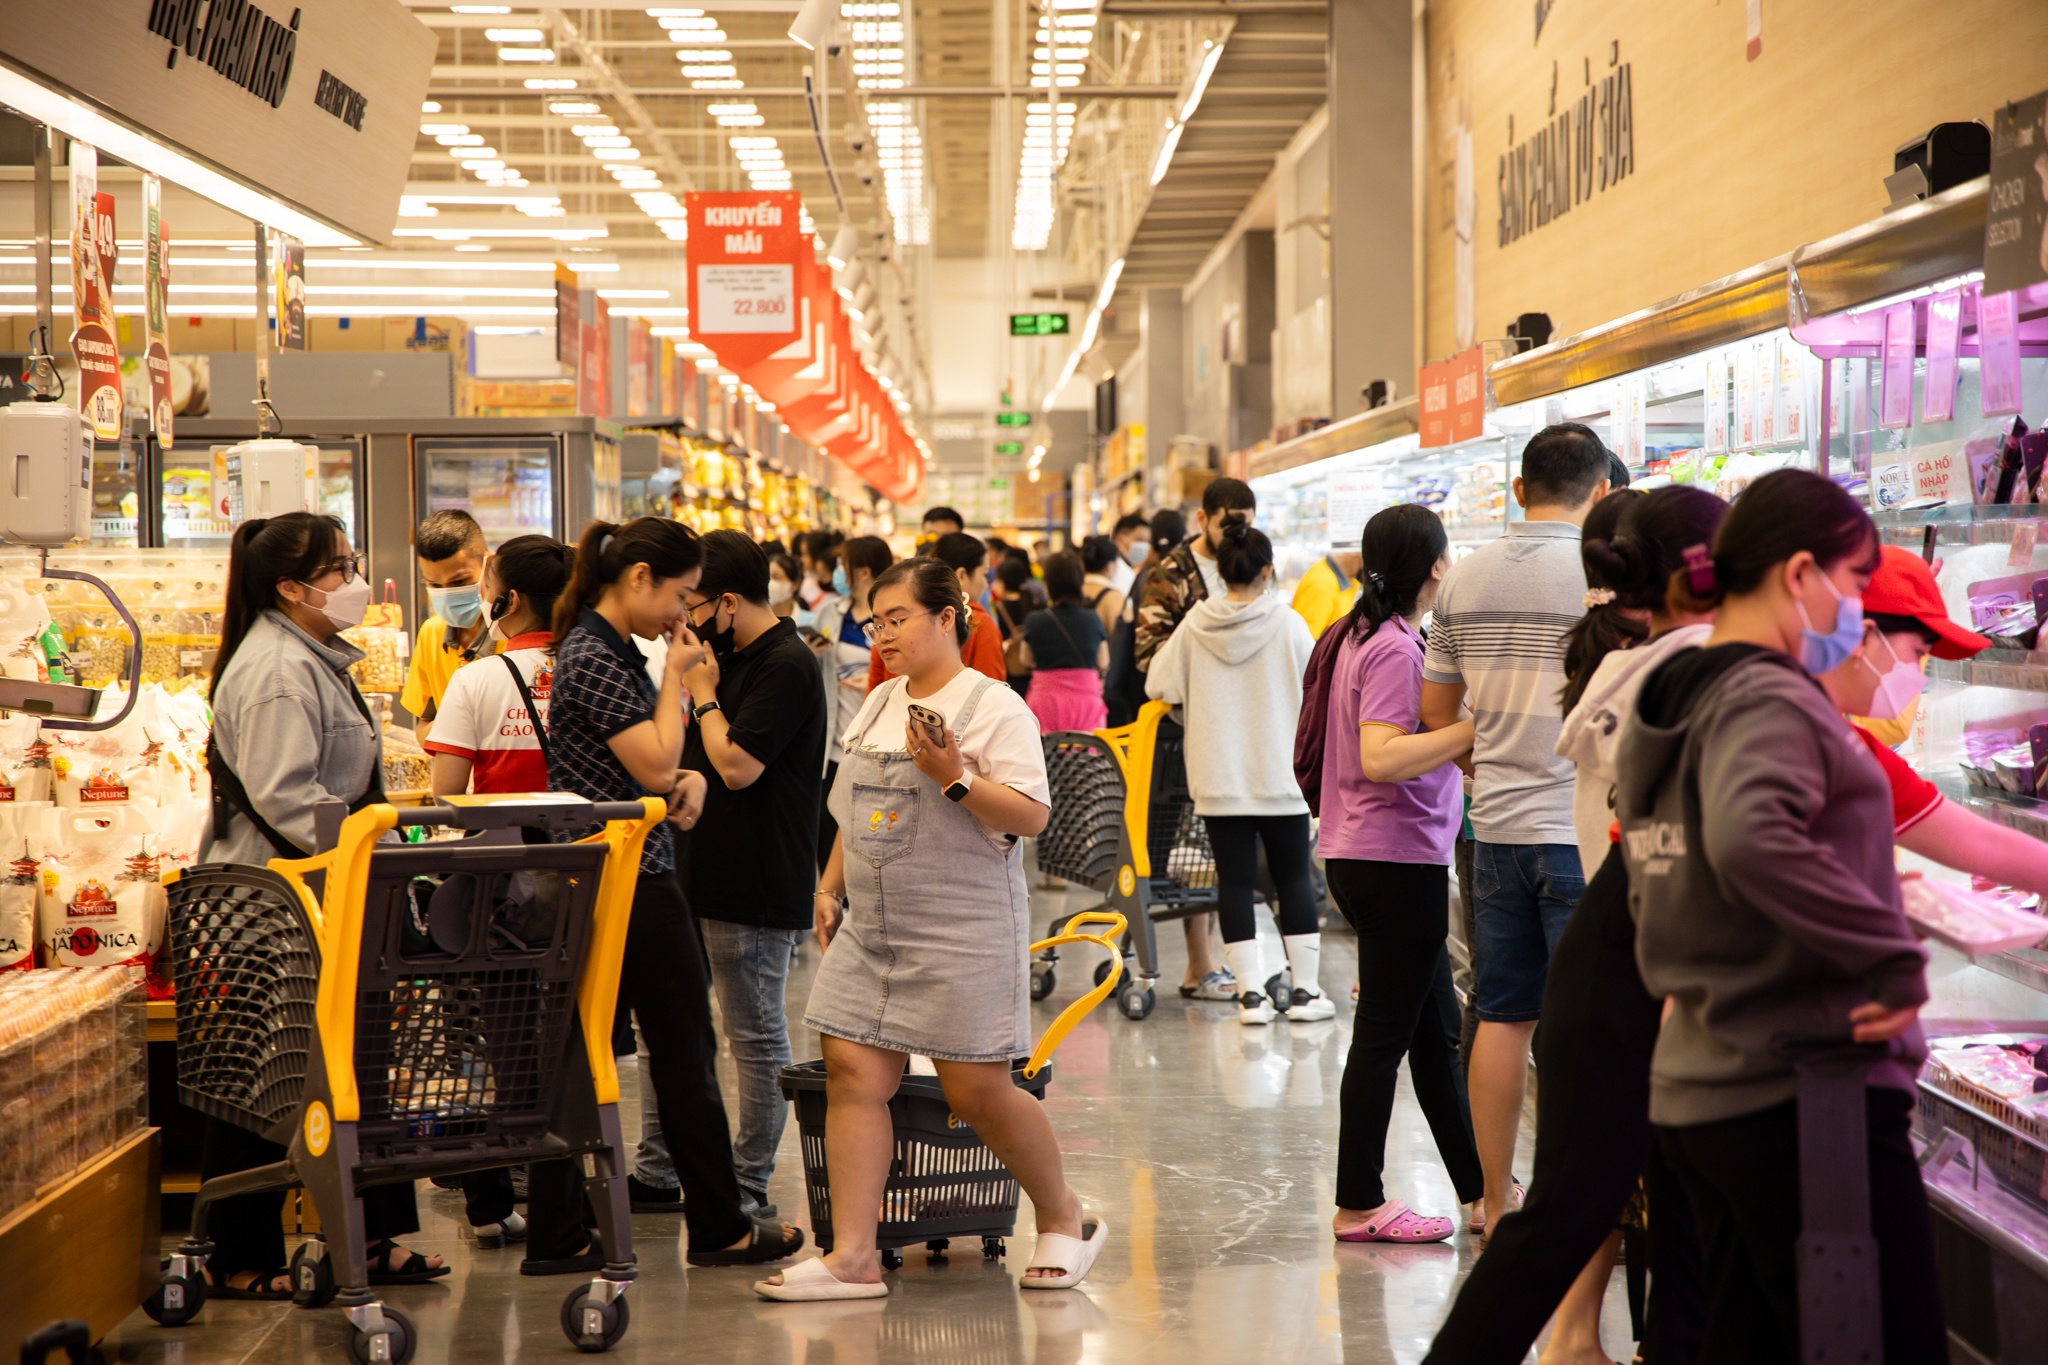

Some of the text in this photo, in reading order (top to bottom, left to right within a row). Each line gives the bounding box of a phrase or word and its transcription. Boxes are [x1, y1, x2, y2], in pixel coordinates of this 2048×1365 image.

[705, 200, 782, 227] KHUYẾN
[1920, 473, 1949, 489] NHẬP
[83, 789, 126, 800] Neptune
[70, 903, 114, 914] Neptune
[52, 933, 138, 959] JAPONICA
